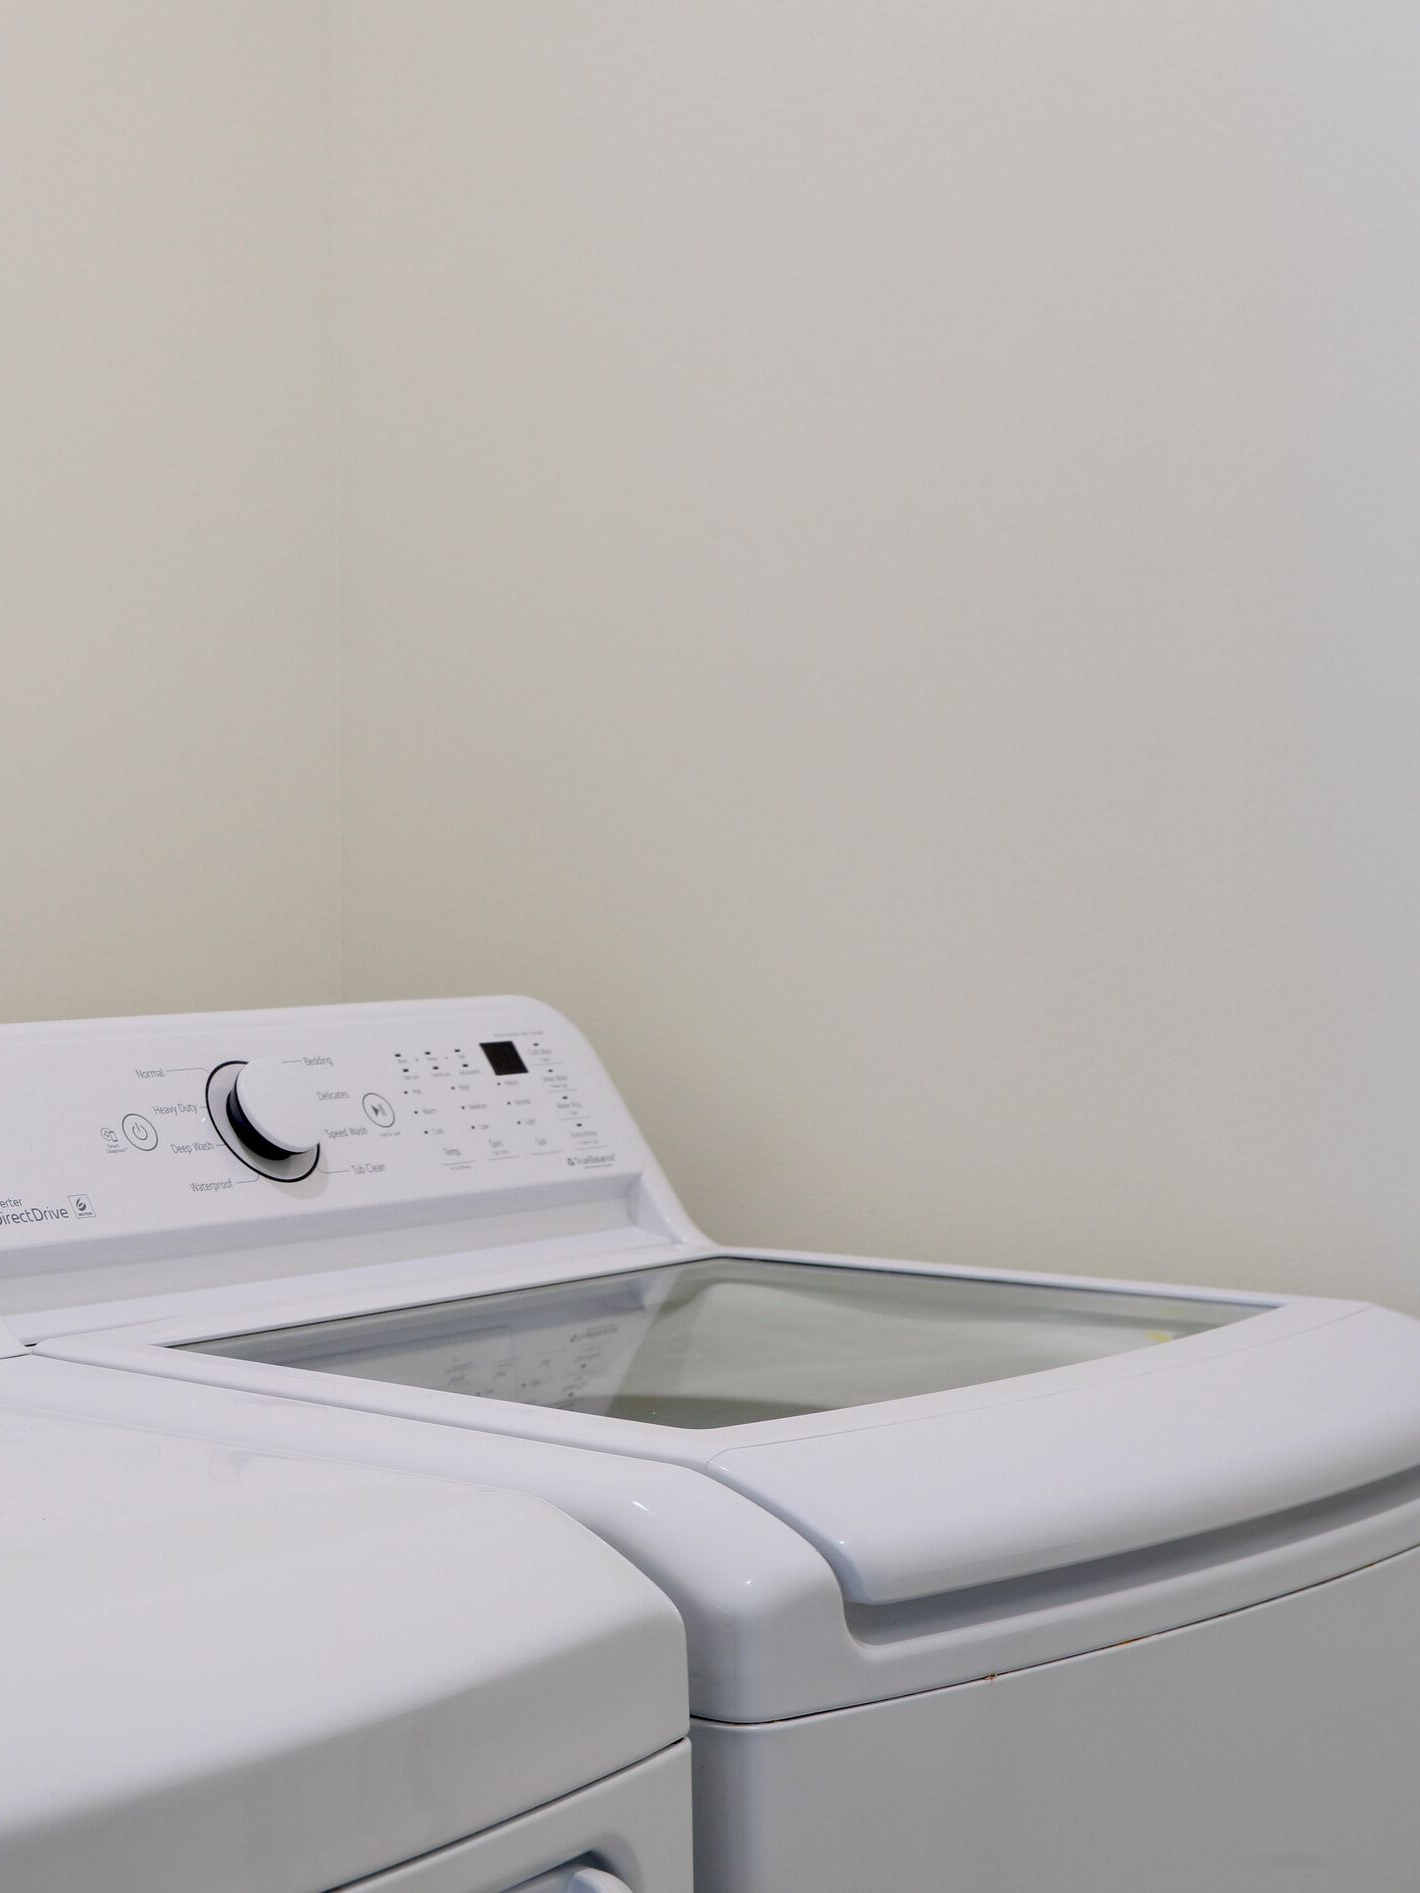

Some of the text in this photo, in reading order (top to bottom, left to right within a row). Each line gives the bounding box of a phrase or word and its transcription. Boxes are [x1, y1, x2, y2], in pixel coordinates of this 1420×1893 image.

[136, 1068, 165, 1079] Normal
[152, 1103, 198, 1115] Heavy Duty
[170, 1141, 214, 1155] Deep Wash
[189, 1179, 233, 1192] Waterproof
